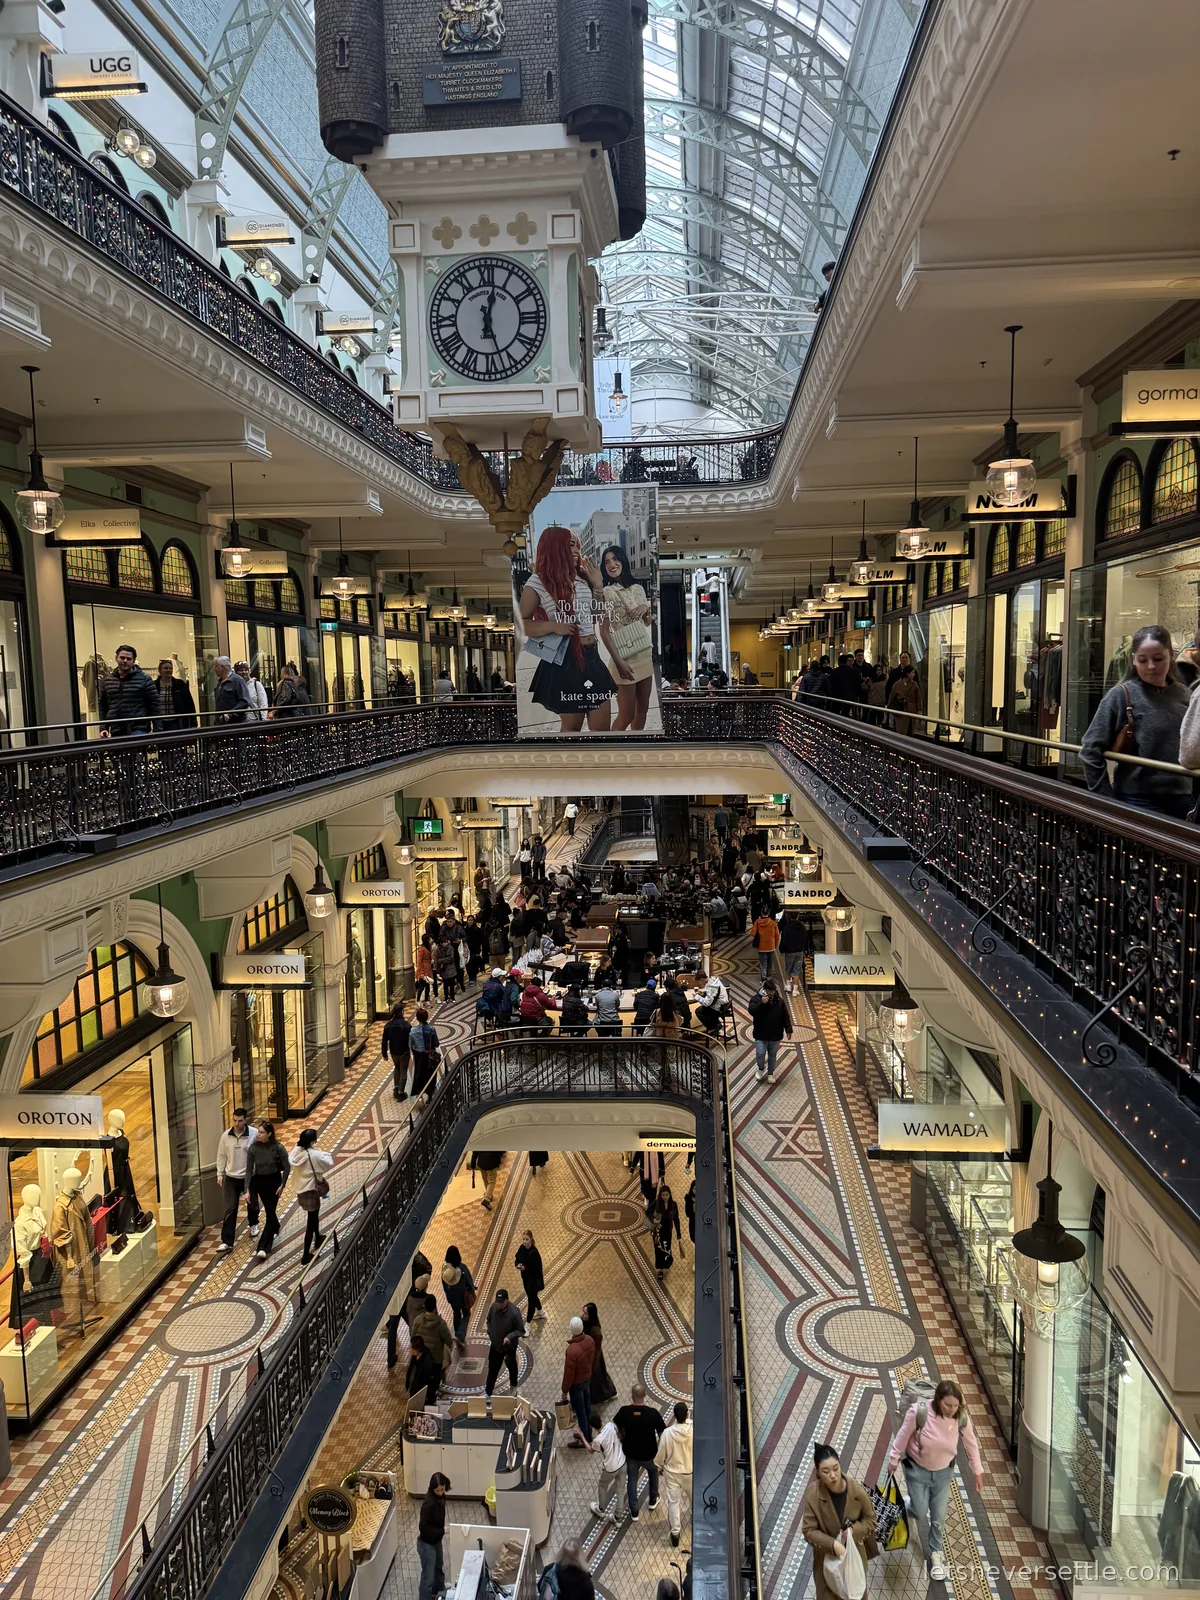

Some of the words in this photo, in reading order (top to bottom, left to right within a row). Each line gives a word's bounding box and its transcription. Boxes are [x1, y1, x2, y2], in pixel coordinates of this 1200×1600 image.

[90, 56, 132, 73] UGG
[462, 76, 503, 84] CLOCKMAKERS
[1138, 388, 1200, 405] gorma
[80, 520, 96, 528] Elka
[559, 599, 571, 612] To
[572, 599, 588, 611] the
[590, 599, 614, 611] Ones
[554, 612, 576, 624] Who
[578, 612, 606, 626] Carry
[608, 610, 620, 623] Us
[560, 691, 583, 701] kate
[586, 690, 618, 703] spade
[362, 889, 400, 897] OROTON
[247, 965, 298, 974] OROTON
[829, 965, 885, 975] WAMADA
[18, 1111, 92, 1125] OROTON
[903, 1122, 989, 1137] WAMADA
[309, 1508, 331, 1516] Memory
[332, 1508, 349, 1516] Block
